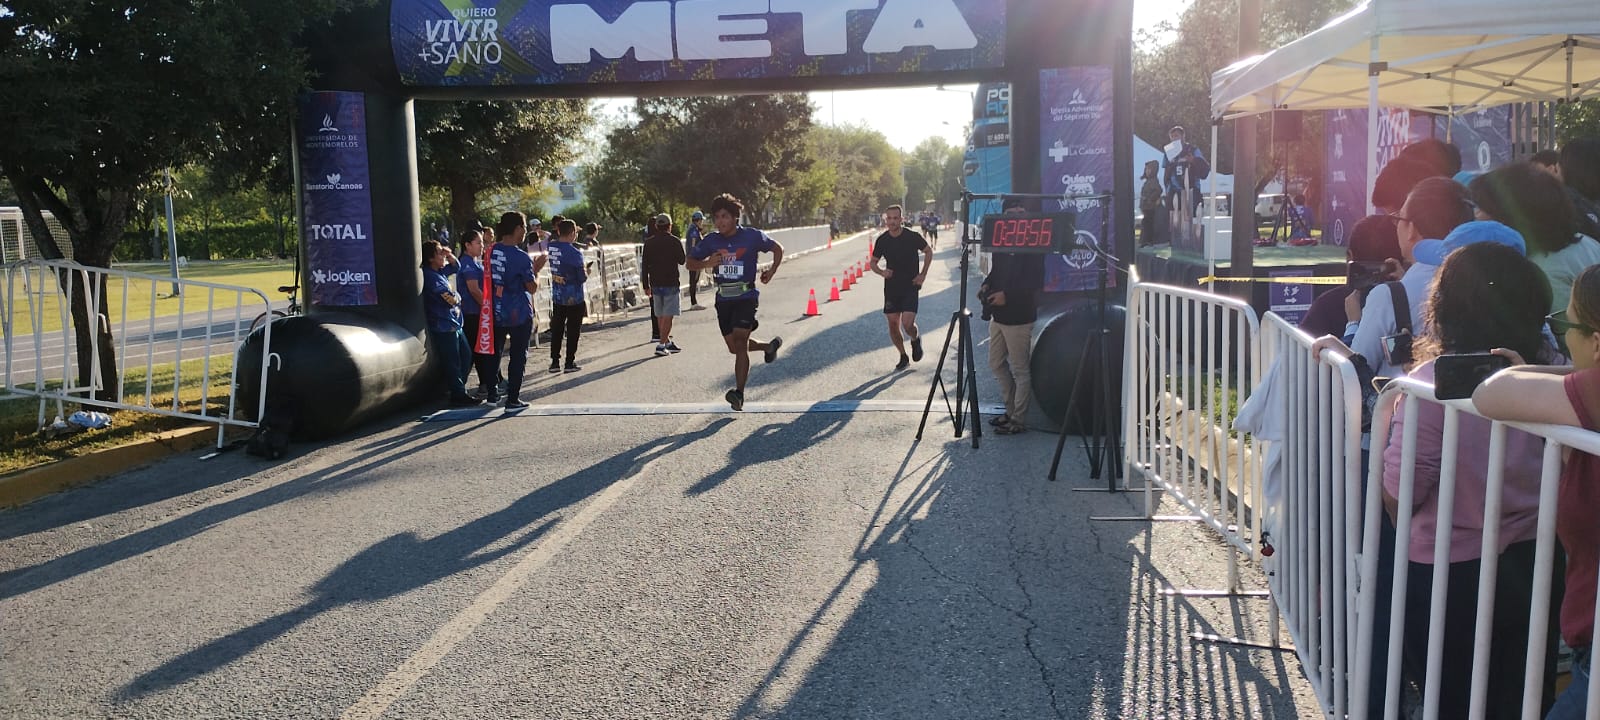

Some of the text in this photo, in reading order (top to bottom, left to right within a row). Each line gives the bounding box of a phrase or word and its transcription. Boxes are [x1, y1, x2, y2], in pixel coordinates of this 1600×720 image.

[452, 7, 497, 18] QUIERO
[425, 18, 498, 42] VIVIR
[549, 0, 978, 64] META
[418, 41, 502, 64] +SANO
[1061, 174, 1096, 185] Quiero
[311, 224, 367, 240] TOTAL
[992, 218, 1052, 246] 0:28:56
[326, 269, 371, 285] Jogken
[723, 266, 739, 274] 308
